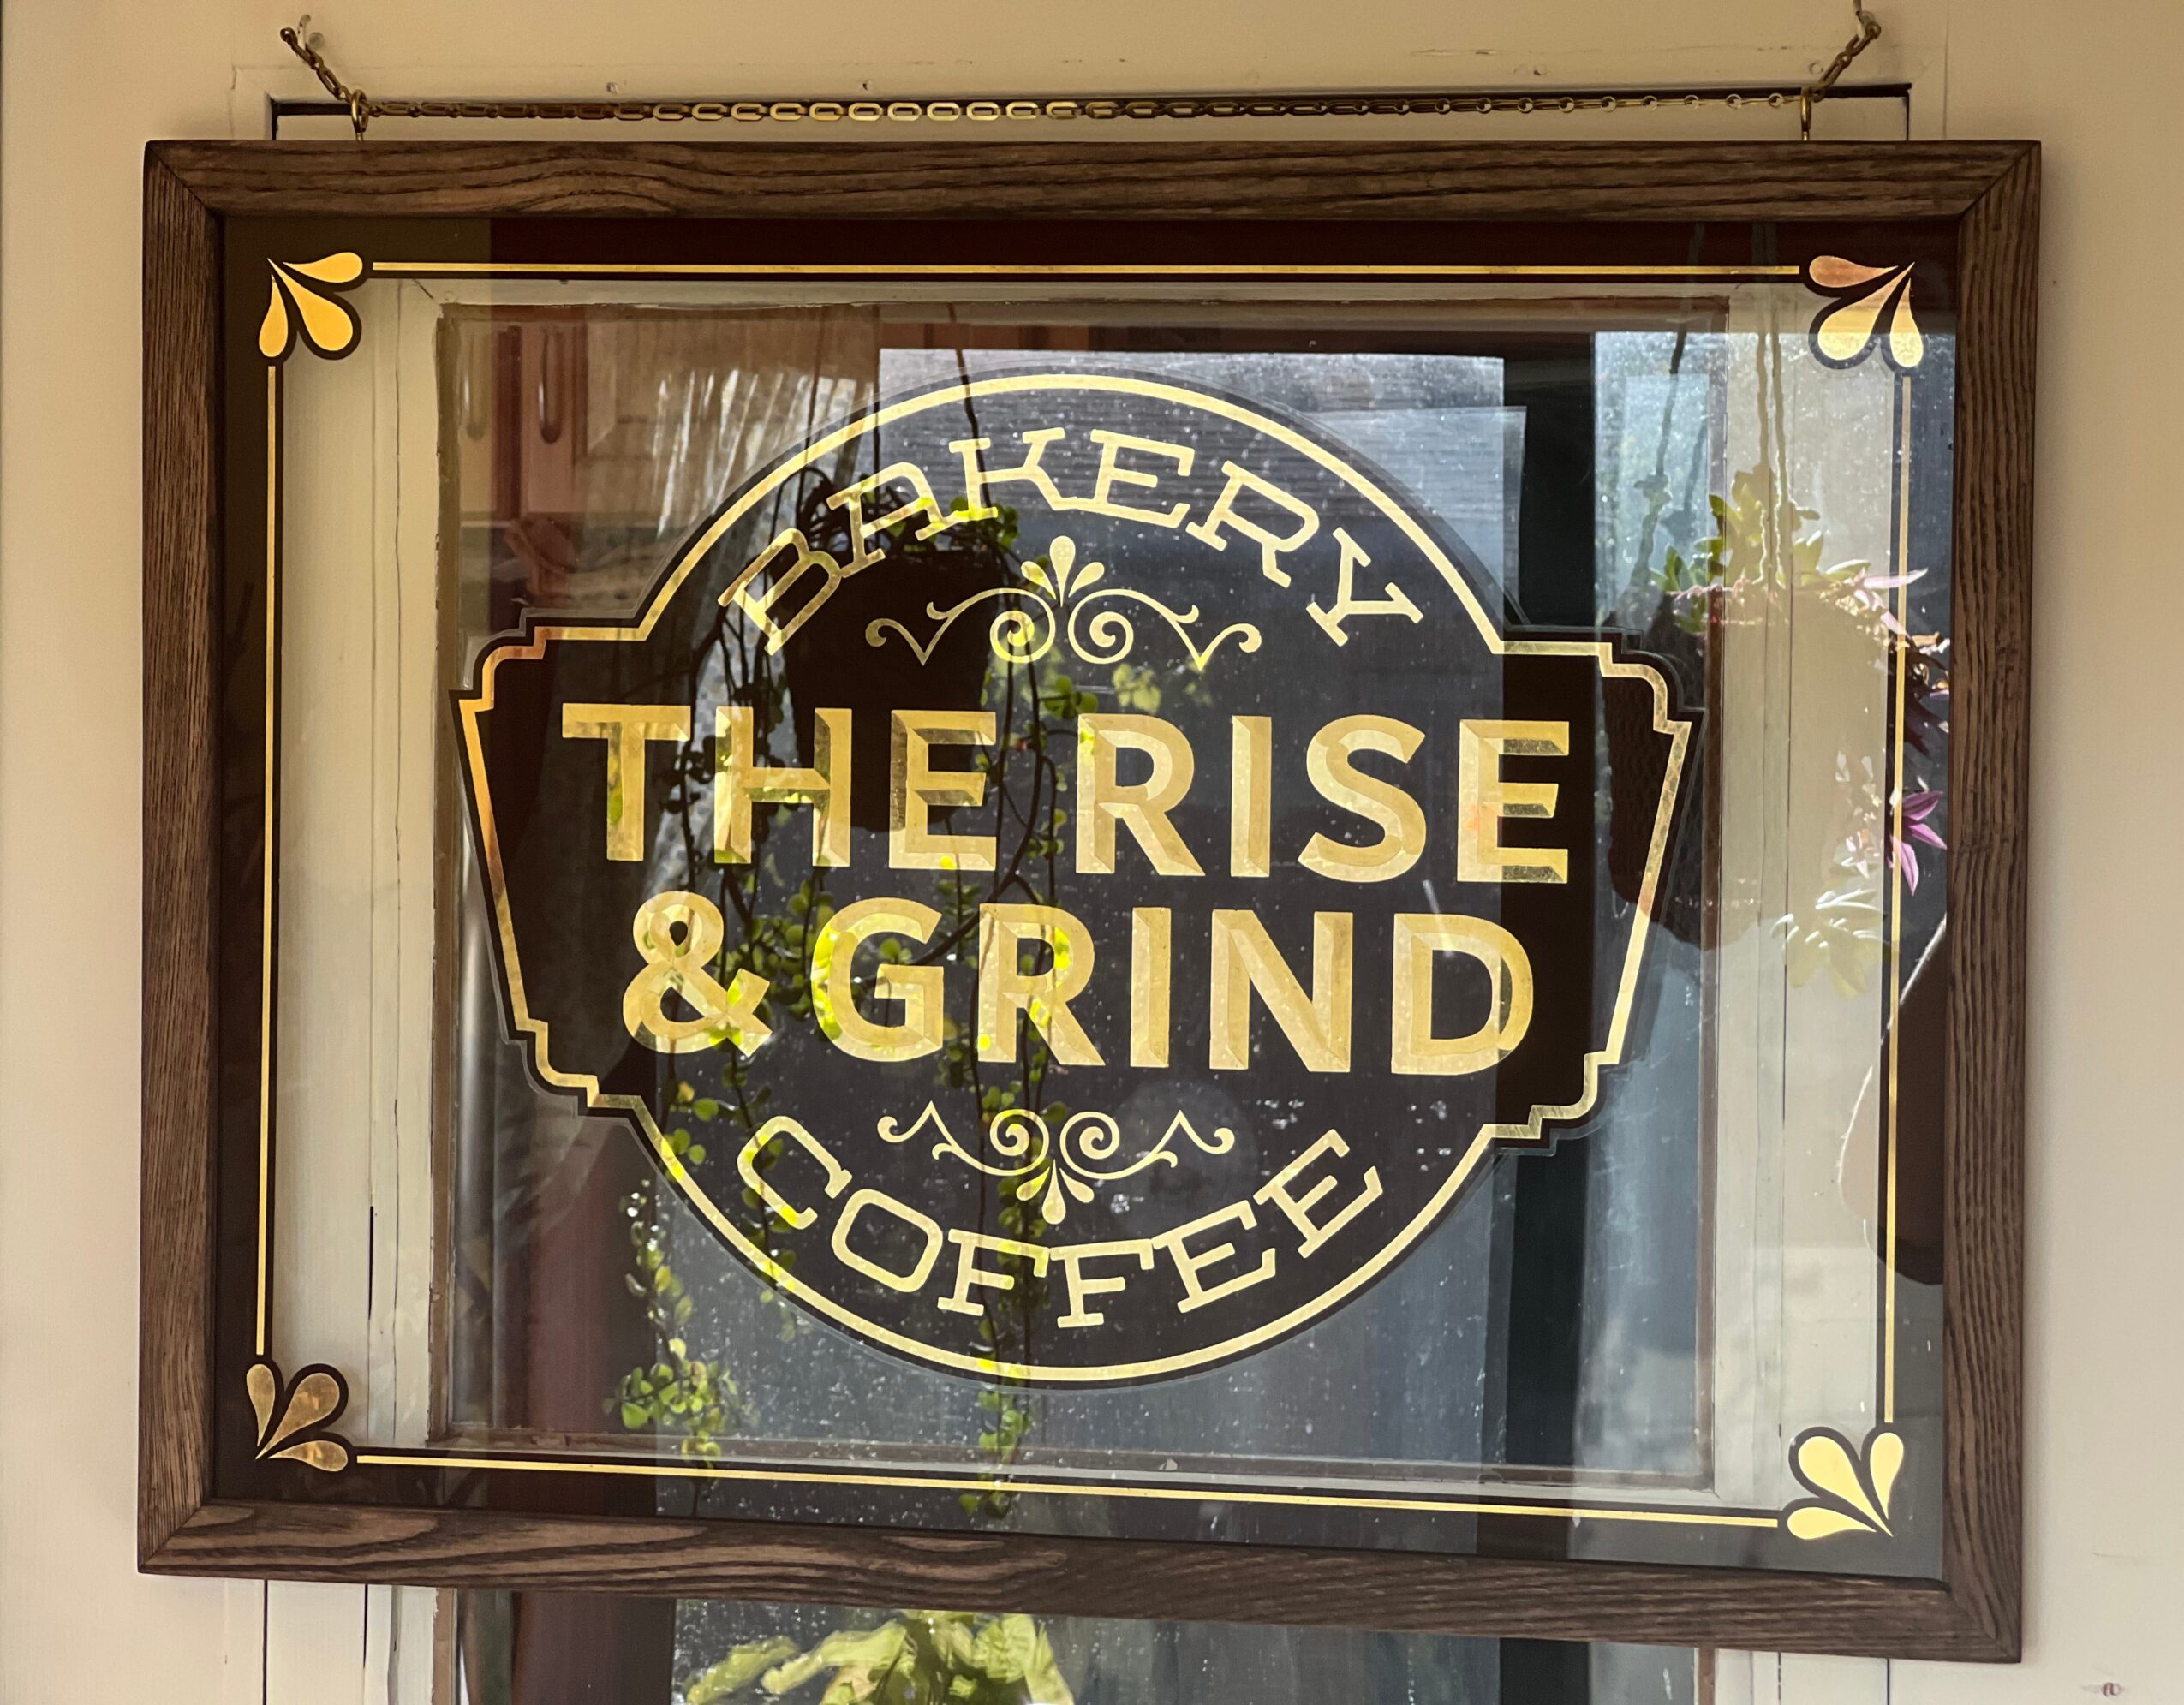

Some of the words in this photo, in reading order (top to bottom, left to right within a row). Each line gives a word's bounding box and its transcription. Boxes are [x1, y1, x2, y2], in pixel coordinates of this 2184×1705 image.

[717, 426, 1423, 655] BAKERY
[562, 703, 997, 871] THE
[1076, 713, 1569, 884] RISE
[623, 891, 773, 1057] &
[811, 897, 1534, 1076] GRIND
[737, 1115, 1383, 1328] COFFEE
